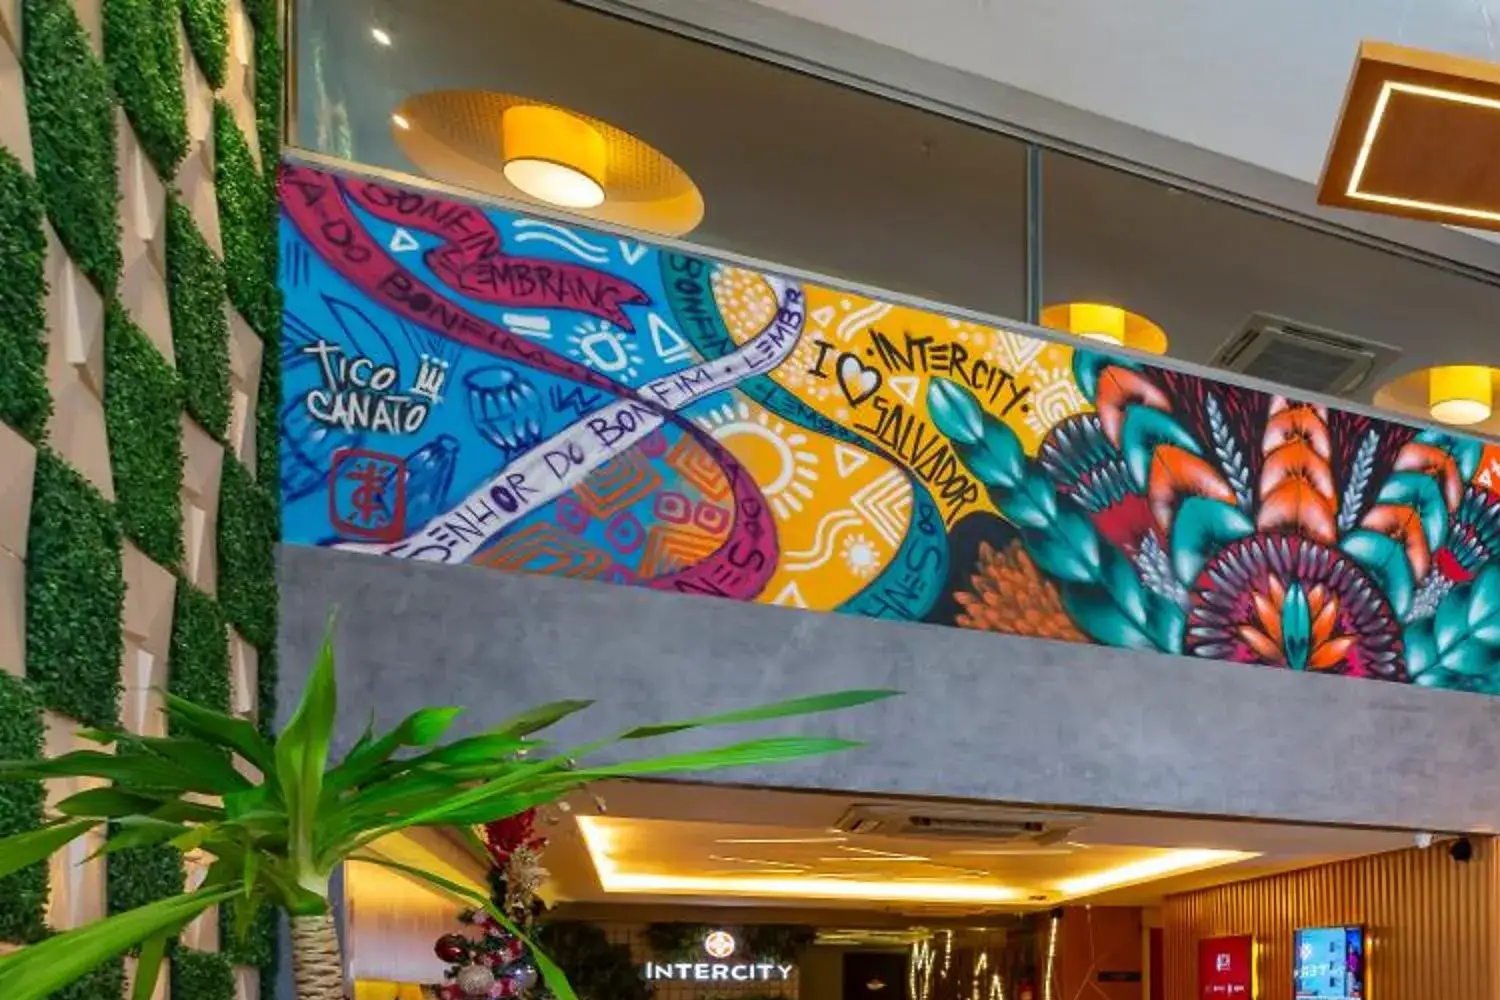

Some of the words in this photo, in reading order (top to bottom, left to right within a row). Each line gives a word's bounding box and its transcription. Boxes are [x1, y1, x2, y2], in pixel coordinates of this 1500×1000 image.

[303, 339, 397, 394] TICO
[868, 329, 1031, 416] INTERCITY
[853, 396, 978, 525] SALVADOR
[645, 961, 793, 980] INTERCITY
